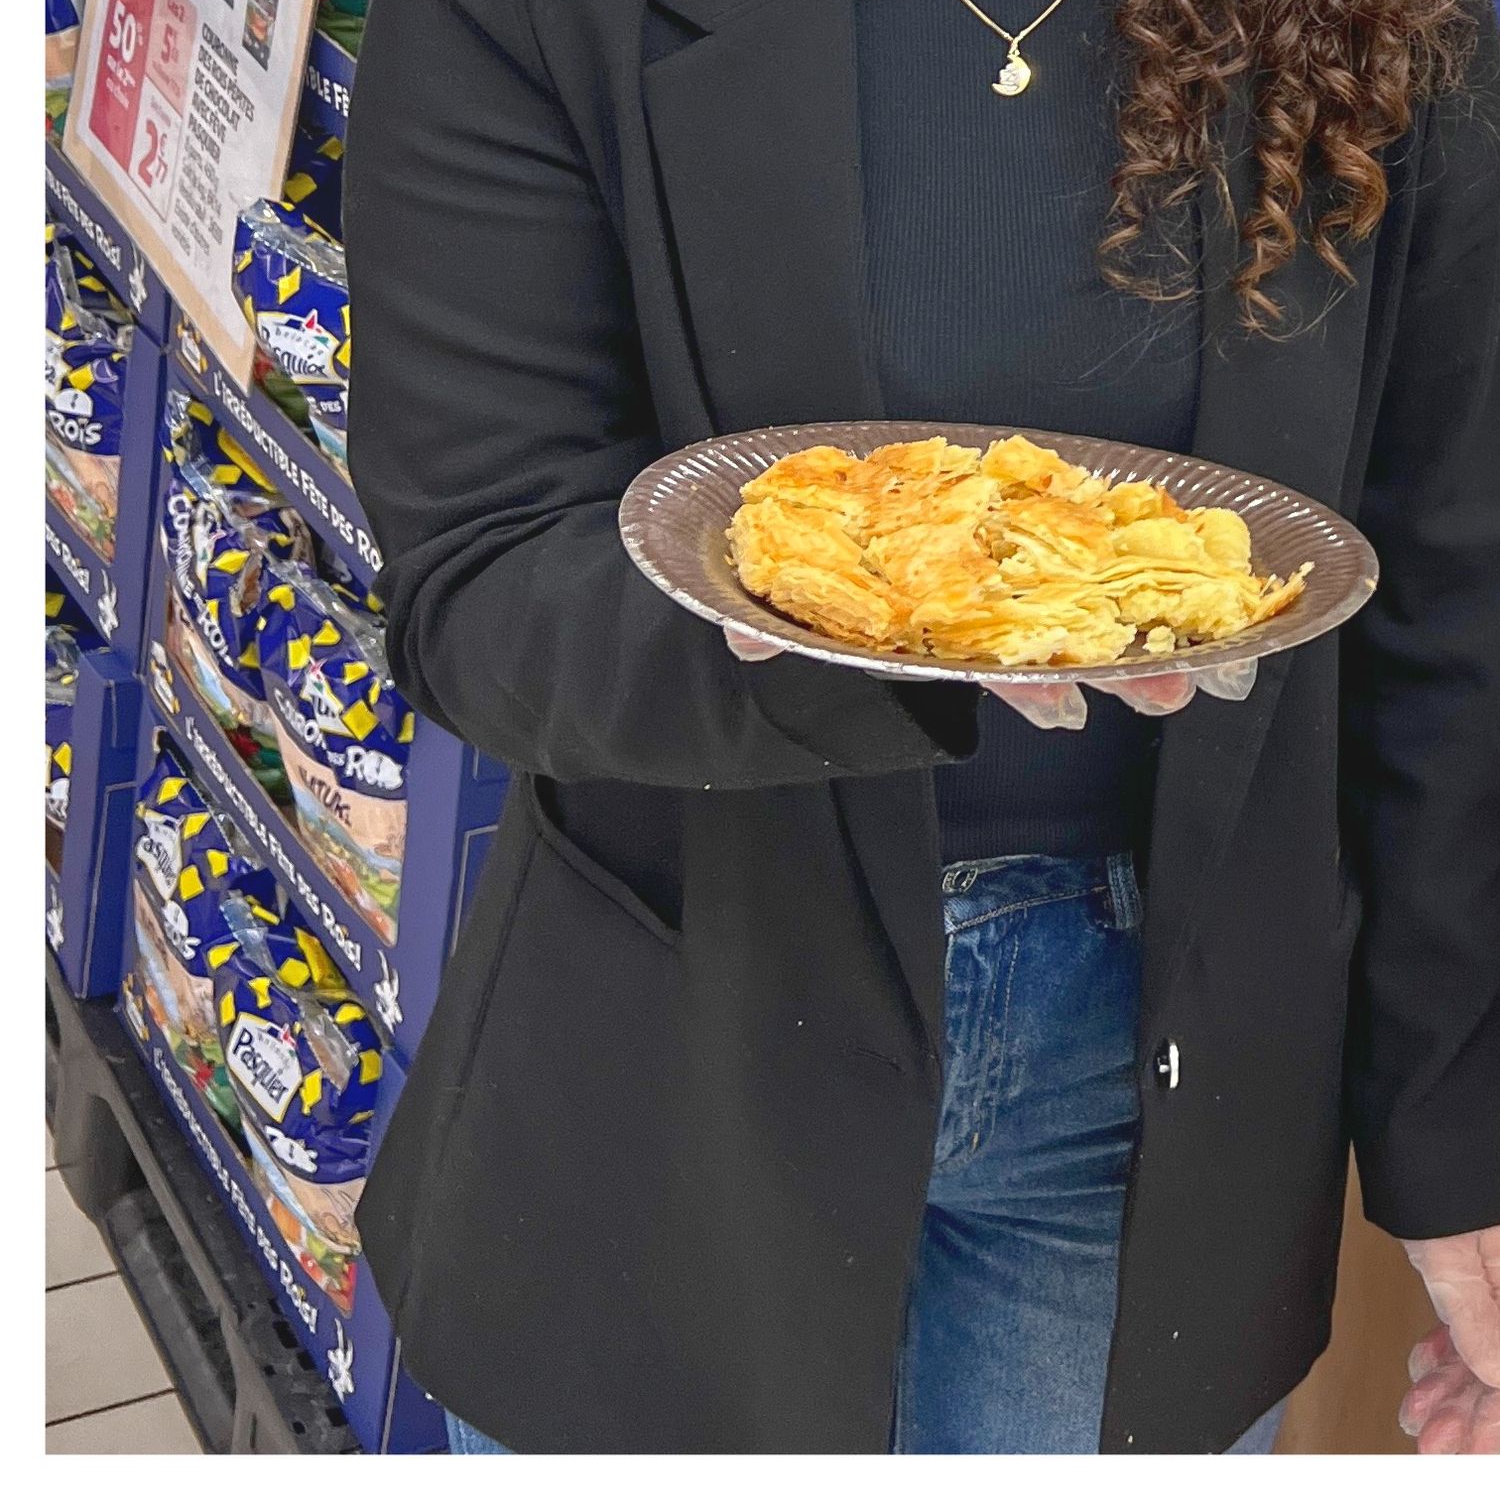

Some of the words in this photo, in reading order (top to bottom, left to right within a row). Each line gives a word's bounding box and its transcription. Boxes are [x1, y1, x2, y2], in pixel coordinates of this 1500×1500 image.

[300, 467, 328, 520] FÊTE
[331, 498, 353, 544] DES
[232, 1028, 289, 1104] Pasquier
